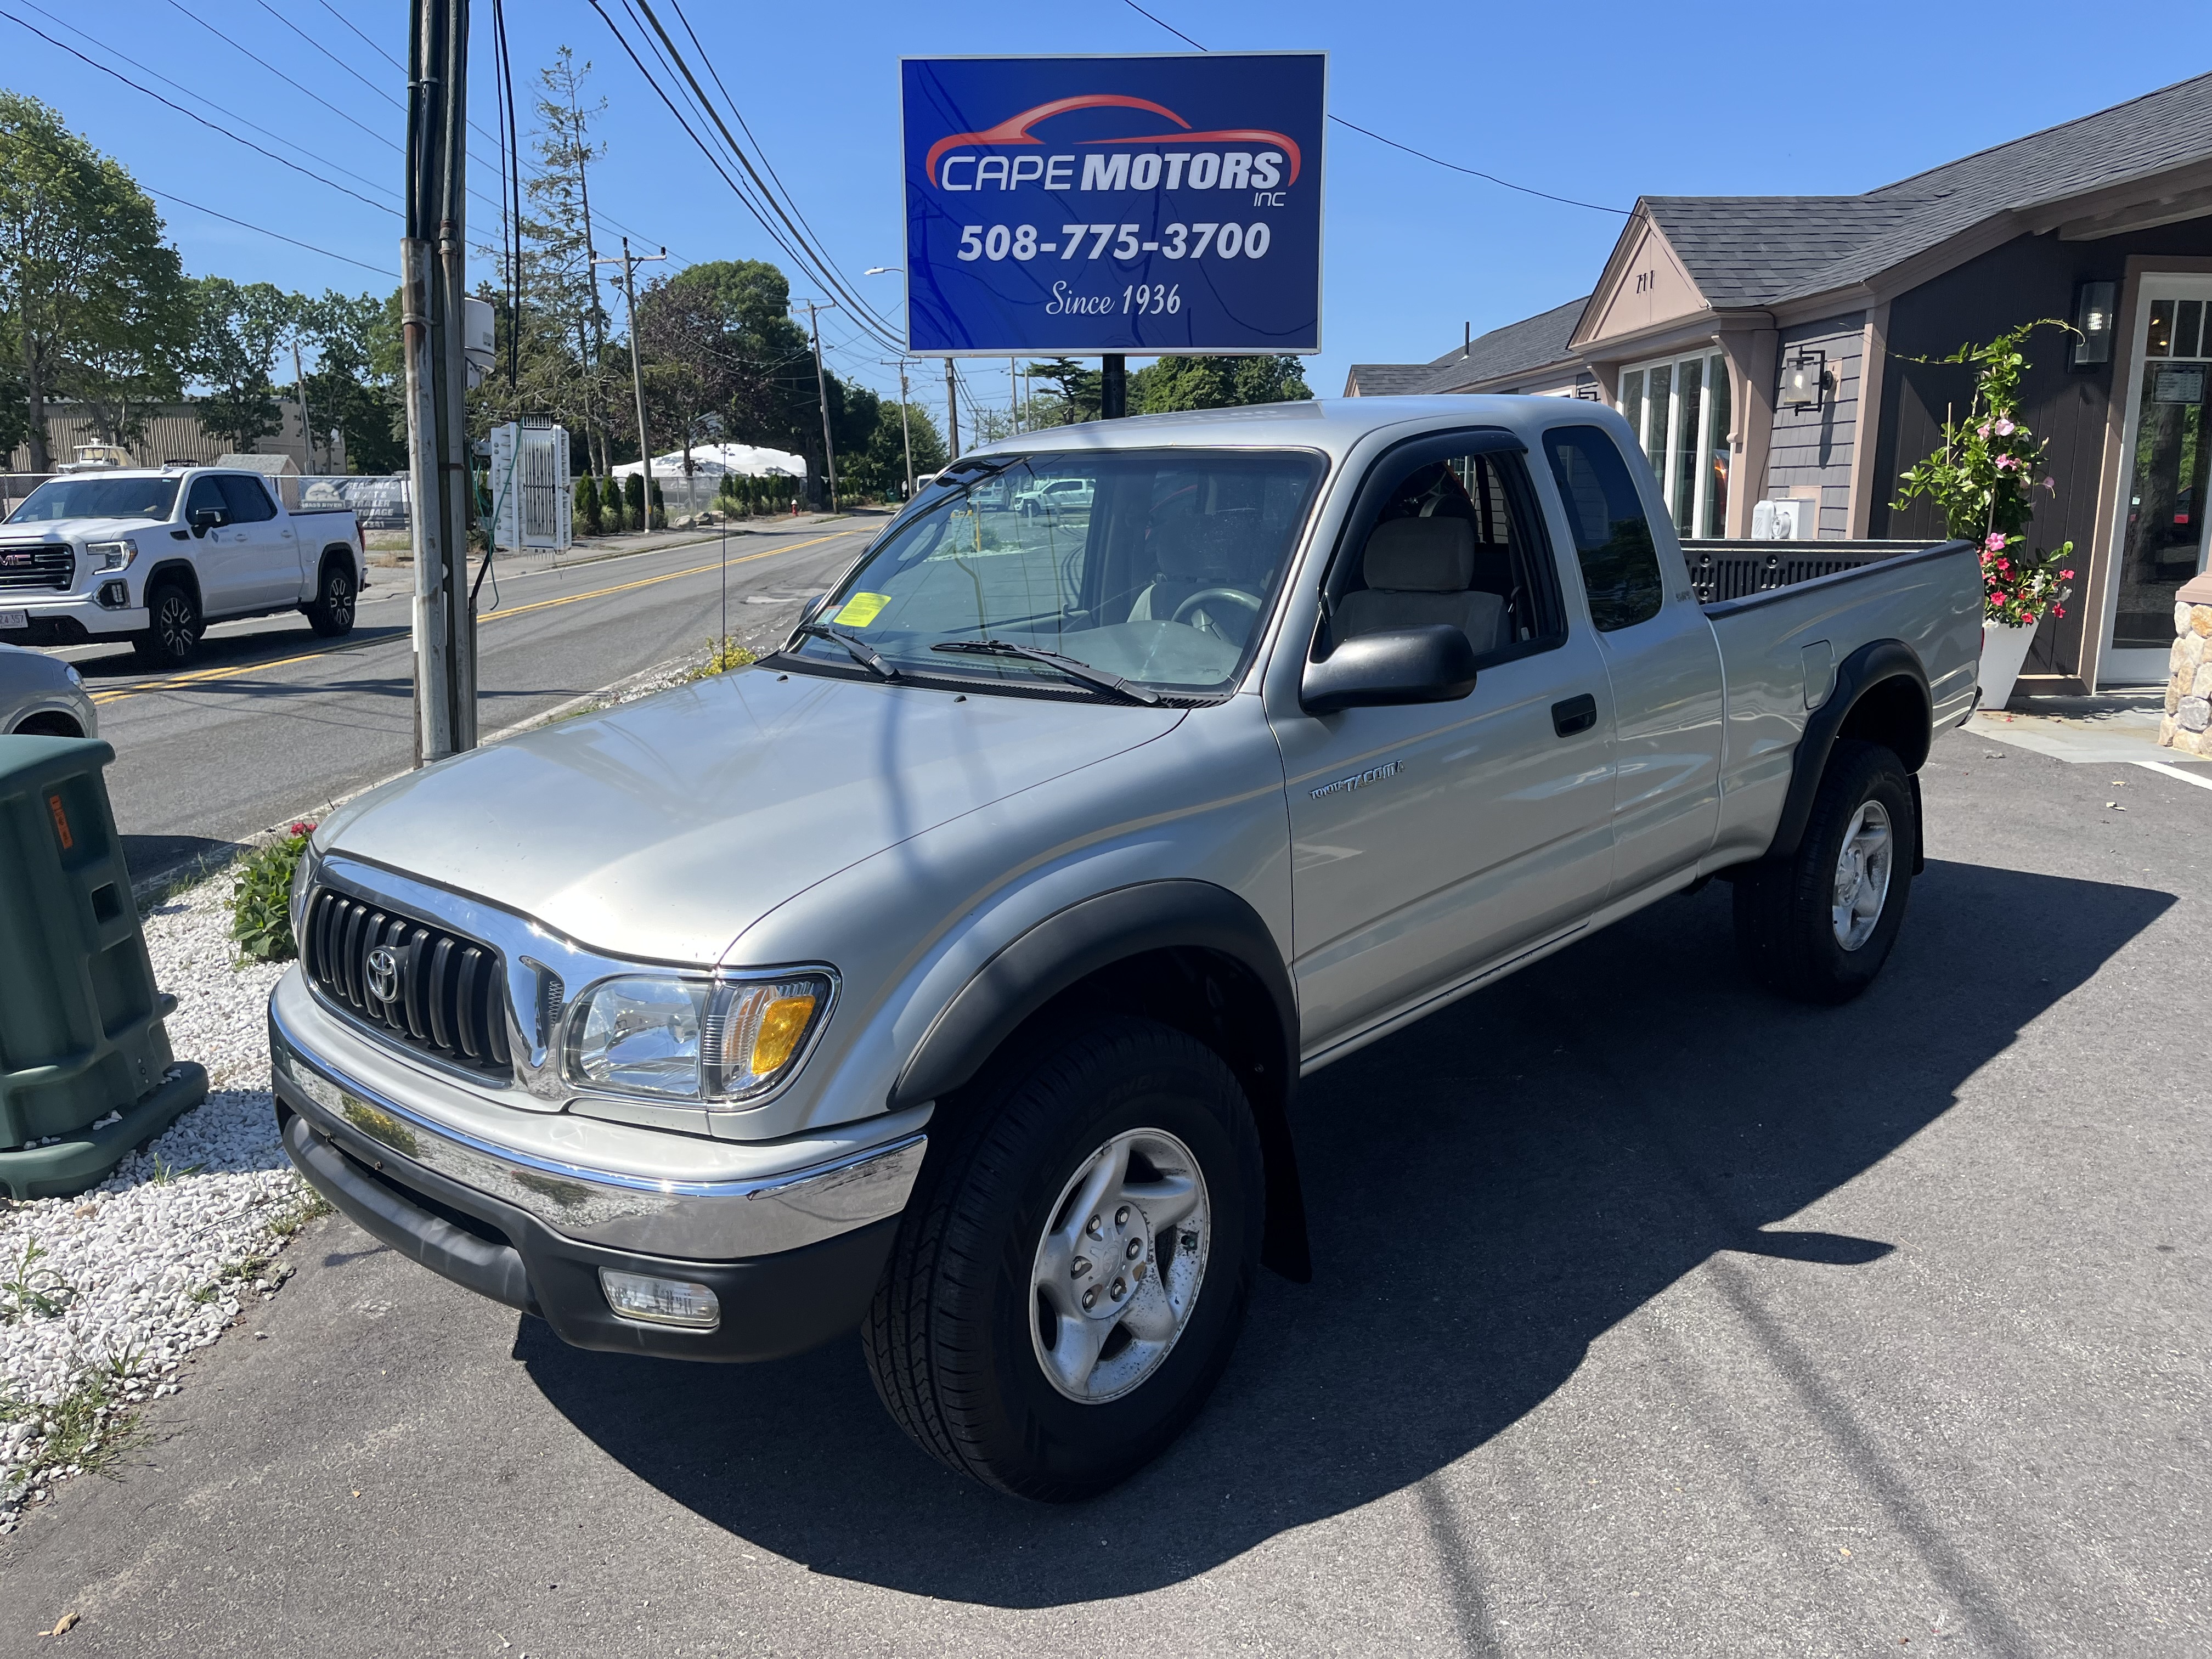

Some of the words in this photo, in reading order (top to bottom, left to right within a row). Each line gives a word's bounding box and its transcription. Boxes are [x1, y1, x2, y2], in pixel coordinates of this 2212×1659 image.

[941, 155, 1075, 191] CAPE
[1080, 151, 1283, 191] MOTORS
[1254, 191, 1286, 207] INC
[956, 221, 1271, 261] 508-775-3700
[1045, 279, 1115, 315] Since
[1122, 283, 1181, 315] 1936
[1310, 781, 1344, 800] TOYOTA
[1344, 759, 1405, 792] TACOMA
